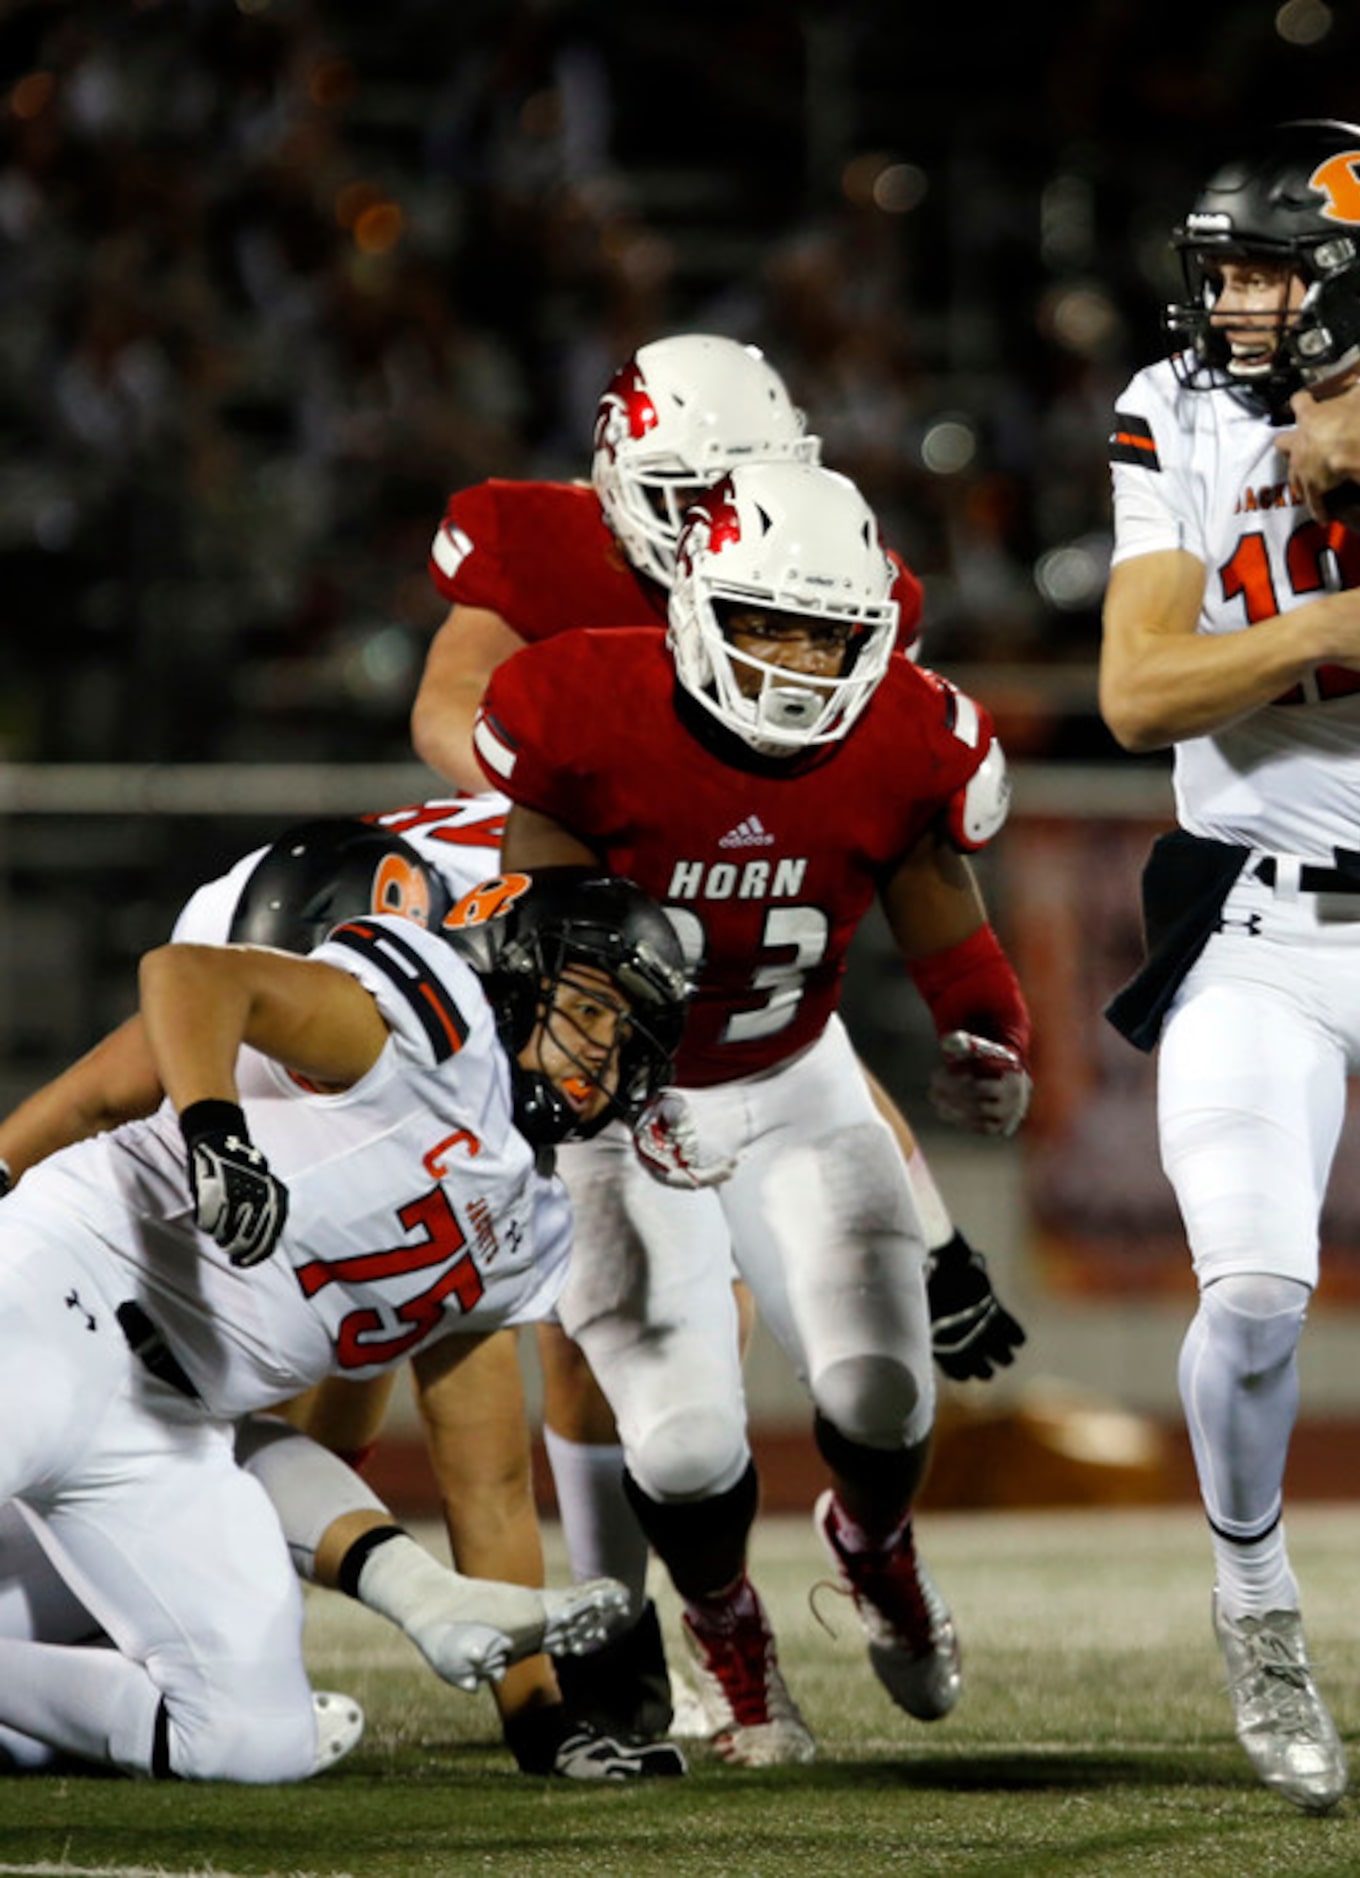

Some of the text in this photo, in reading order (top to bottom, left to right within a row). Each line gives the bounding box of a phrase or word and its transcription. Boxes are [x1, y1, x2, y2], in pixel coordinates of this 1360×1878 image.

[667, 858, 808, 899] HORN
[422, 1129, 480, 1180] C
[294, 1183, 485, 1369] 75
